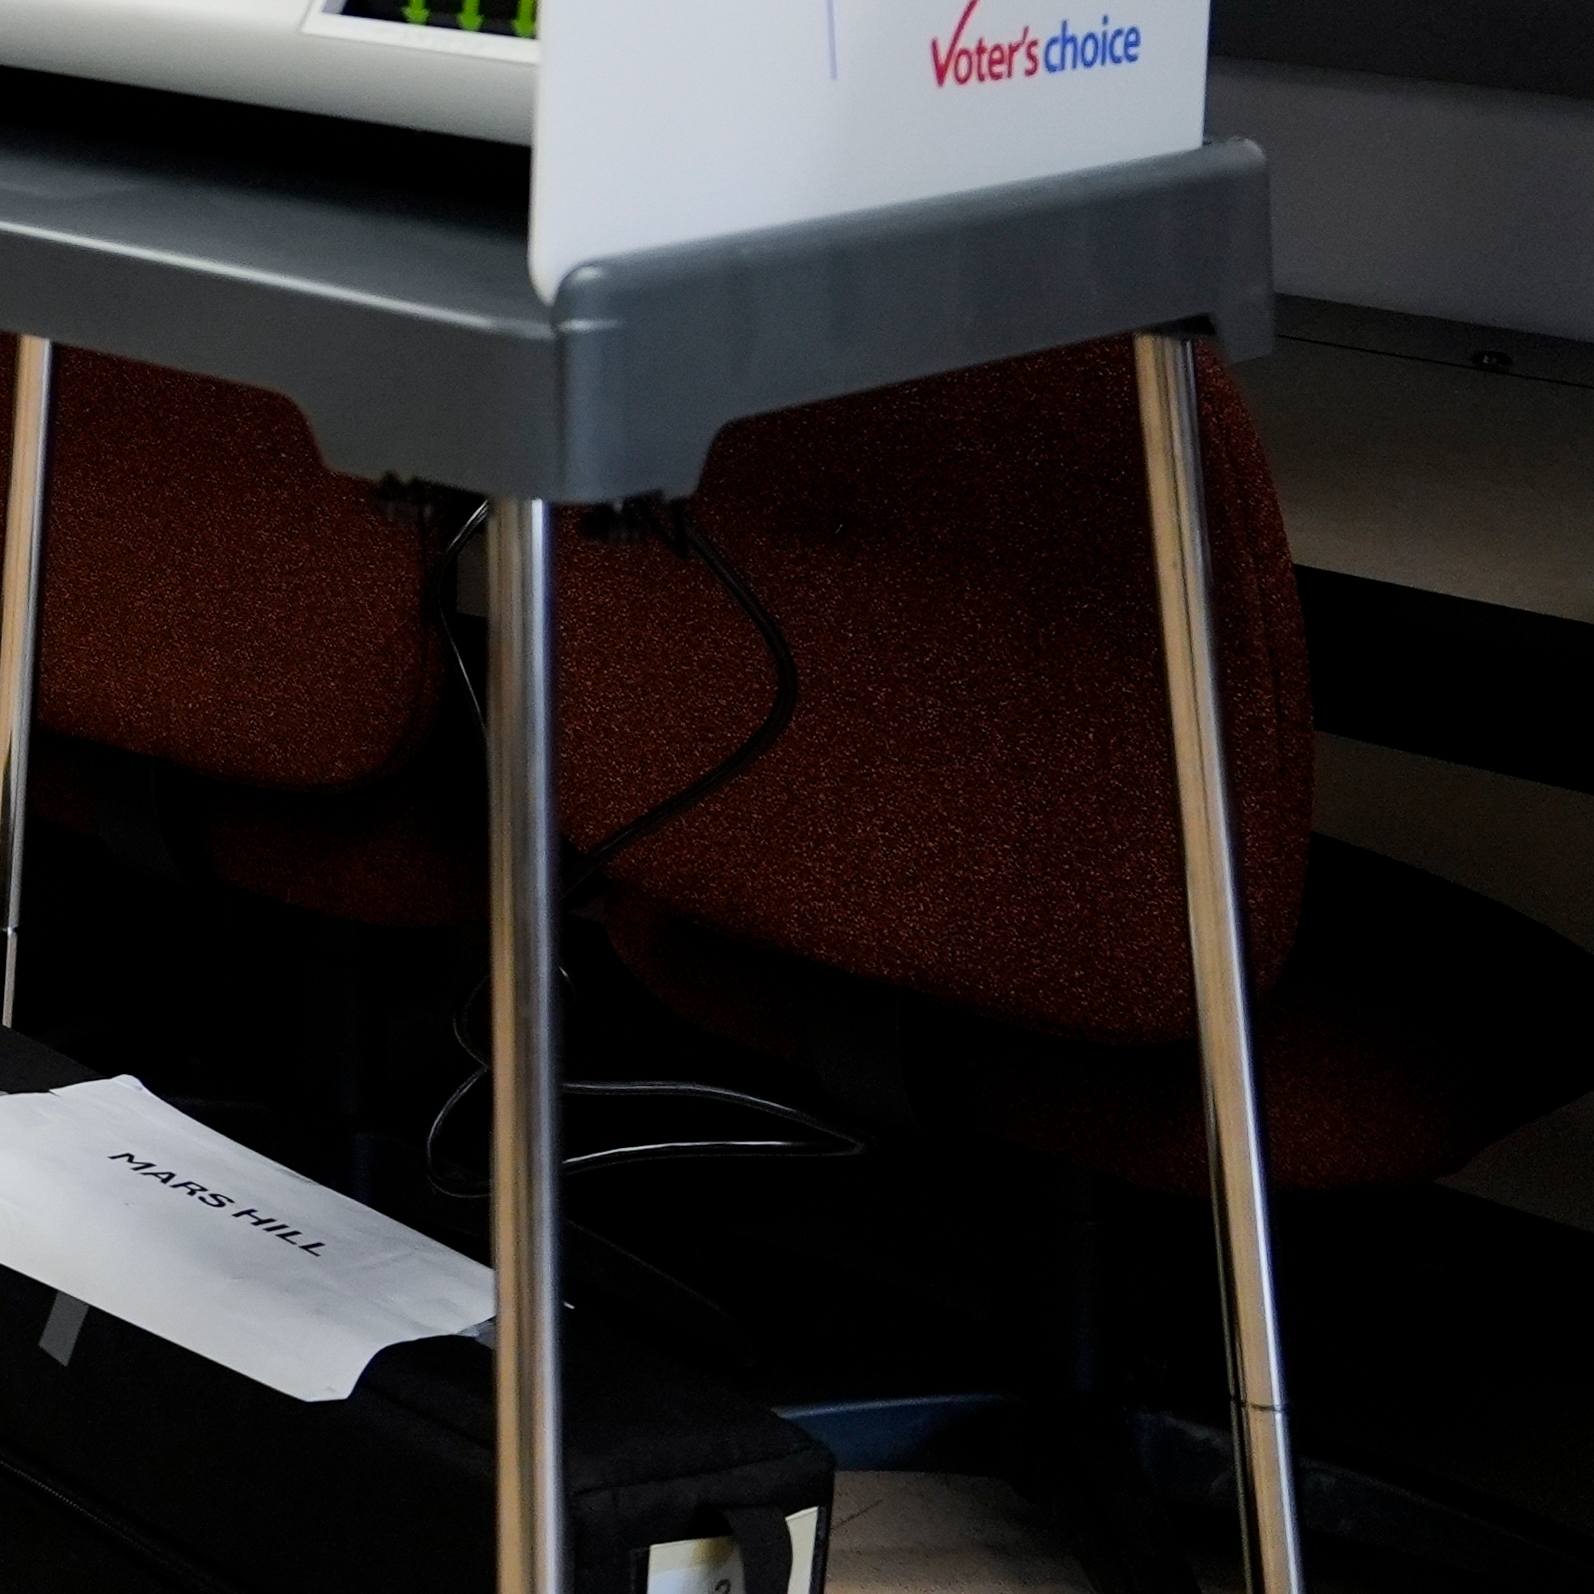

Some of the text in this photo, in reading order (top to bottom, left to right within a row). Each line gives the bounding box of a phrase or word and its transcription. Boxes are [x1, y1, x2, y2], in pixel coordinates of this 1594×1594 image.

[1043, 14, 1142, 74] choice
[108, 1152, 326, 1258] MARS HILL
